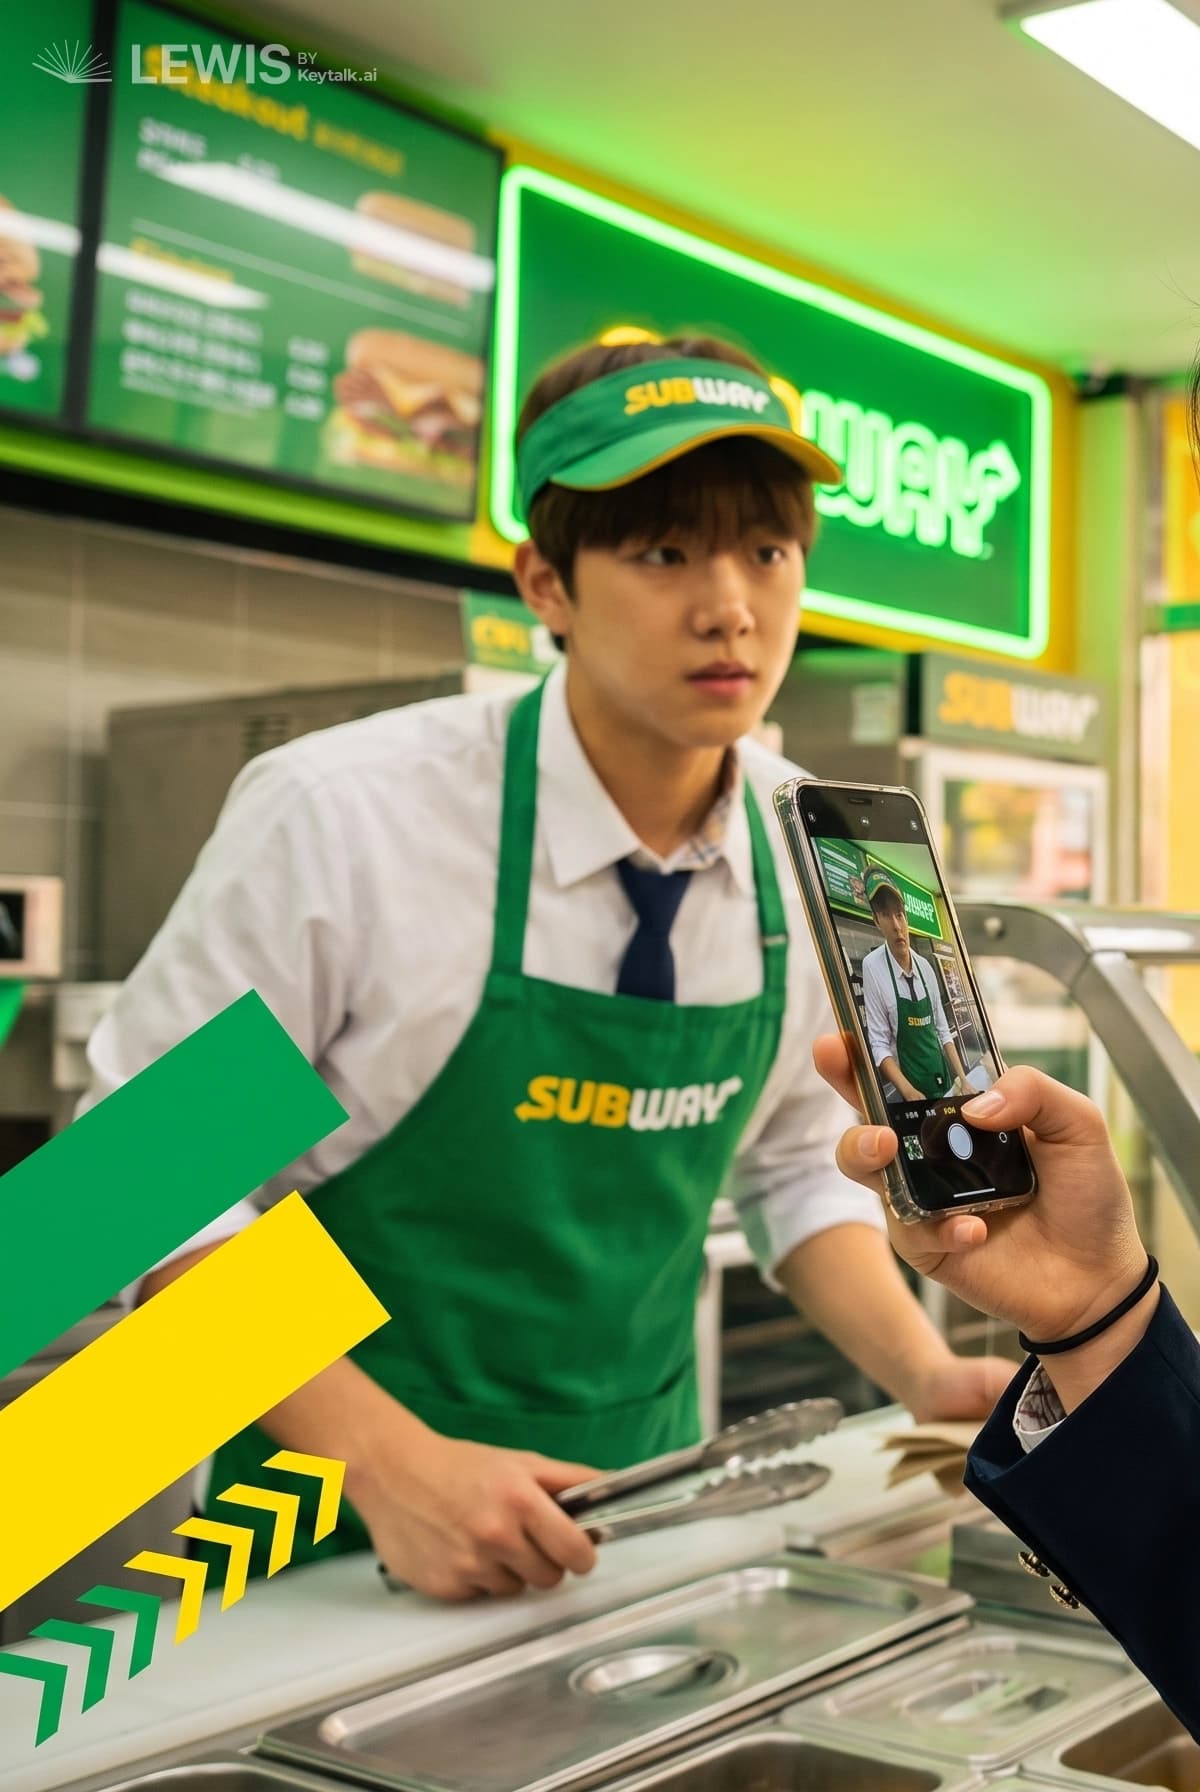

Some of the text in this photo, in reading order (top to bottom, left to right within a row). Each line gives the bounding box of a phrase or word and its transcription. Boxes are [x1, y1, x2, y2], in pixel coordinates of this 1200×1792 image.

[624, 376, 770, 416] SUBWAY
[938, 669, 1099, 744] SUBWAY
[514, 1075, 744, 1131] SUBWAY
